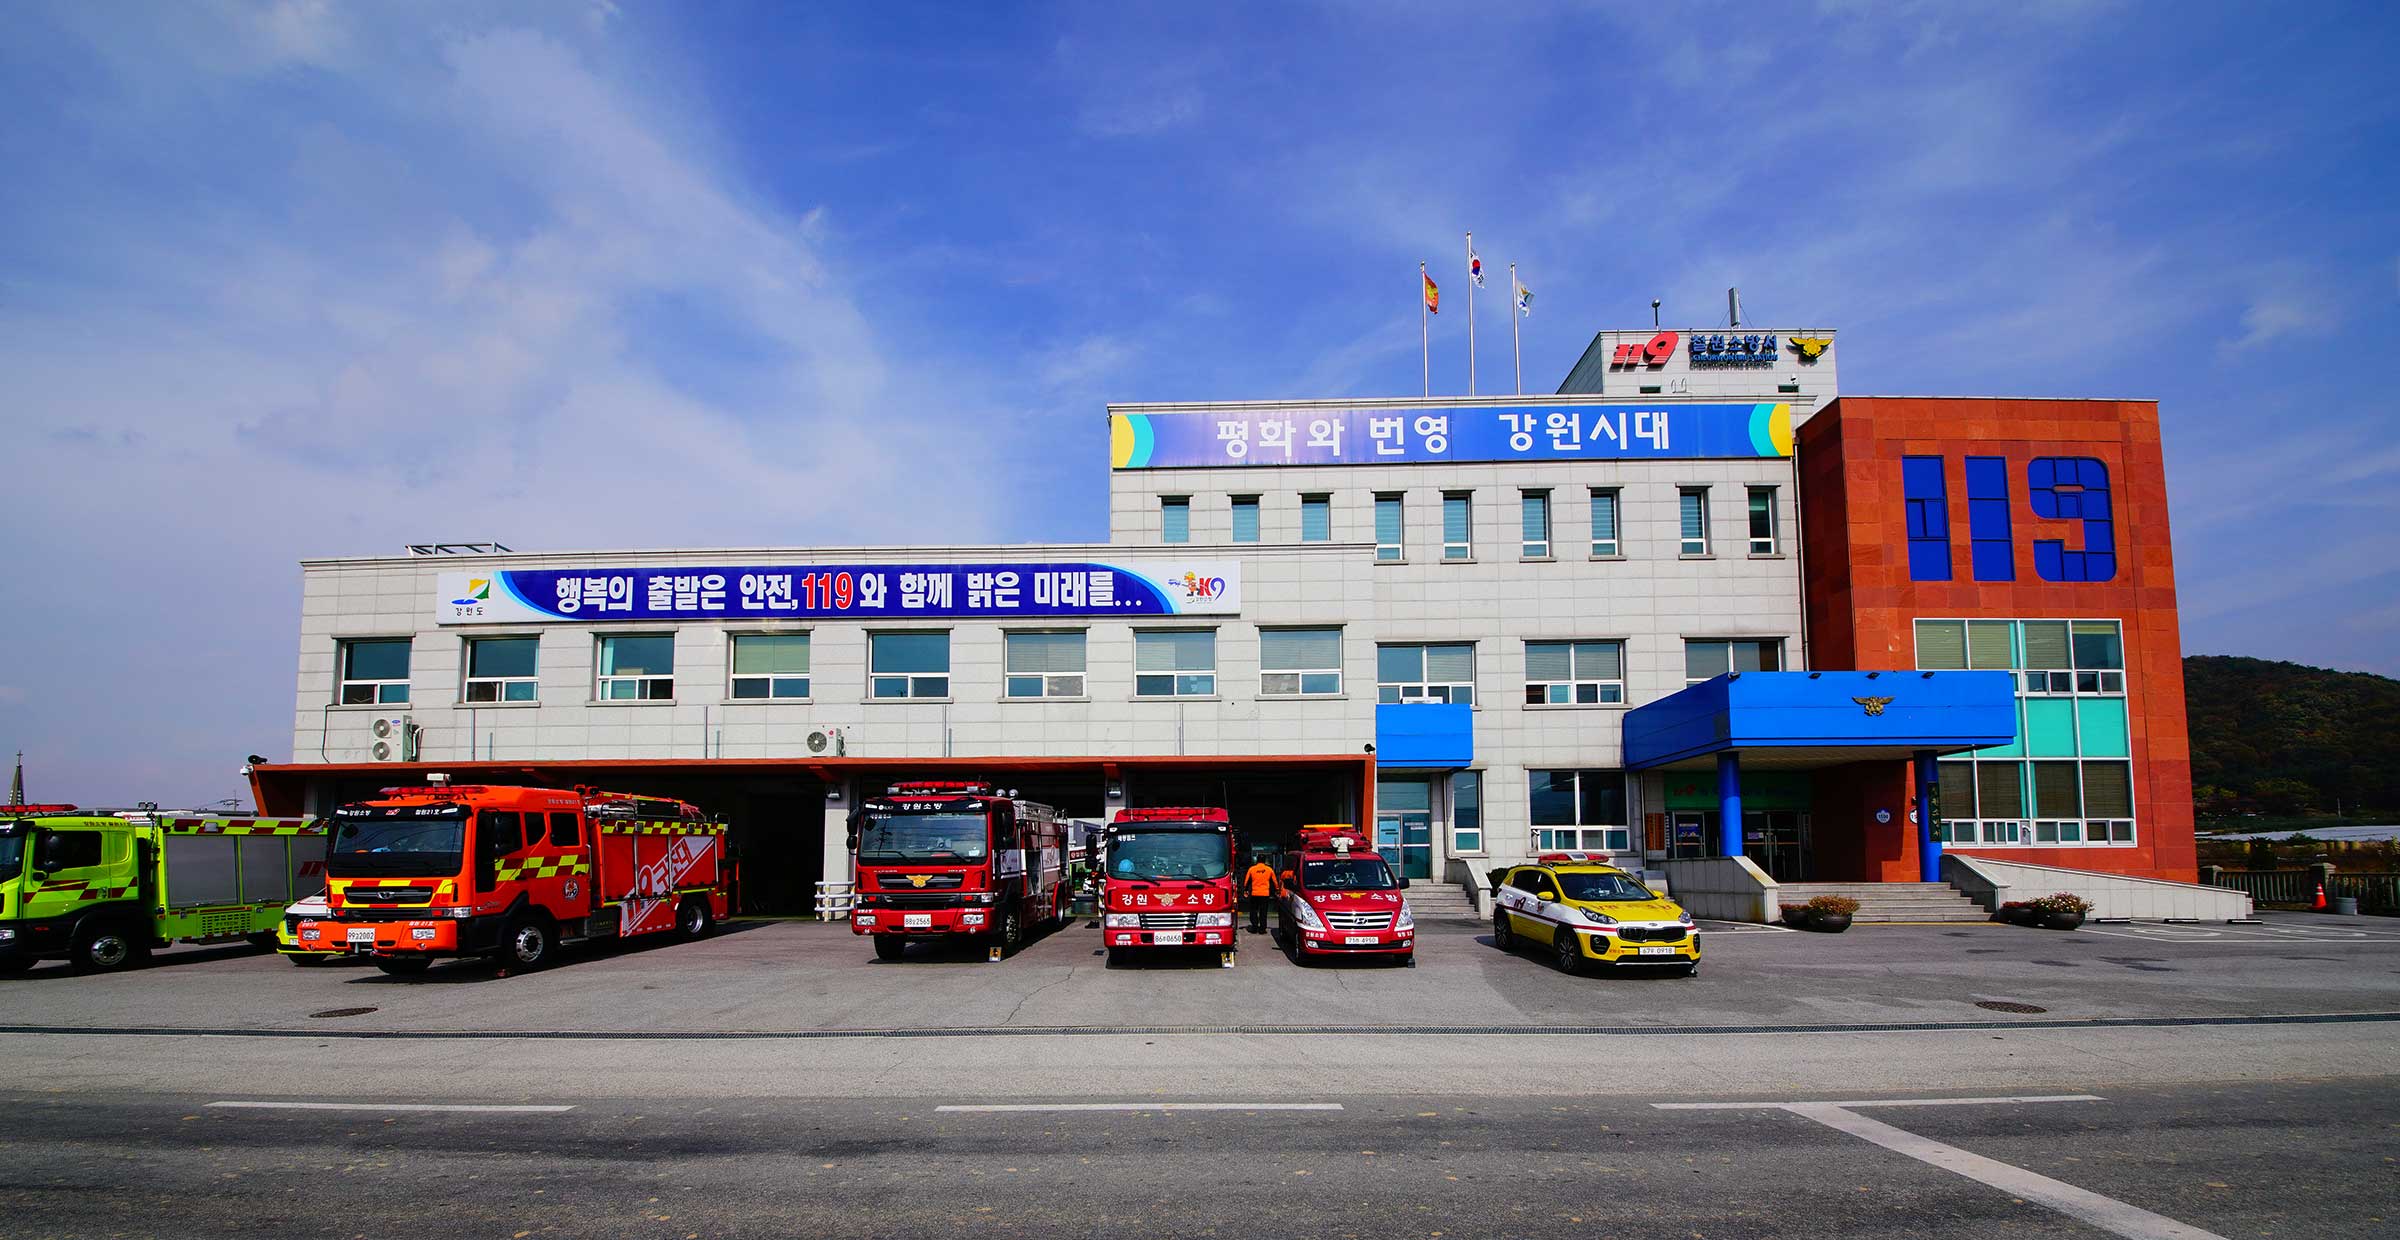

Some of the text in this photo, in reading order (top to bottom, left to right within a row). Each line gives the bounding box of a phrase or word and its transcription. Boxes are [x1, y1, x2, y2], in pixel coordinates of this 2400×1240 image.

[1613, 331, 1680, 364] 119
[1690, 334, 1778, 352] 철원소방서
[1217, 411, 1669, 458] 평화와 번영 강원시대
[1902, 455, 2117, 582] 119
[556, 575, 633, 612] 행복의
[647, 573, 726, 610] 출발은
[899, 572, 953, 609] 함께
[967, 571, 1020, 608] 밝은
[1034, 571, 1142, 607] 미래를...
[455, 606, 483, 617] 강원도
